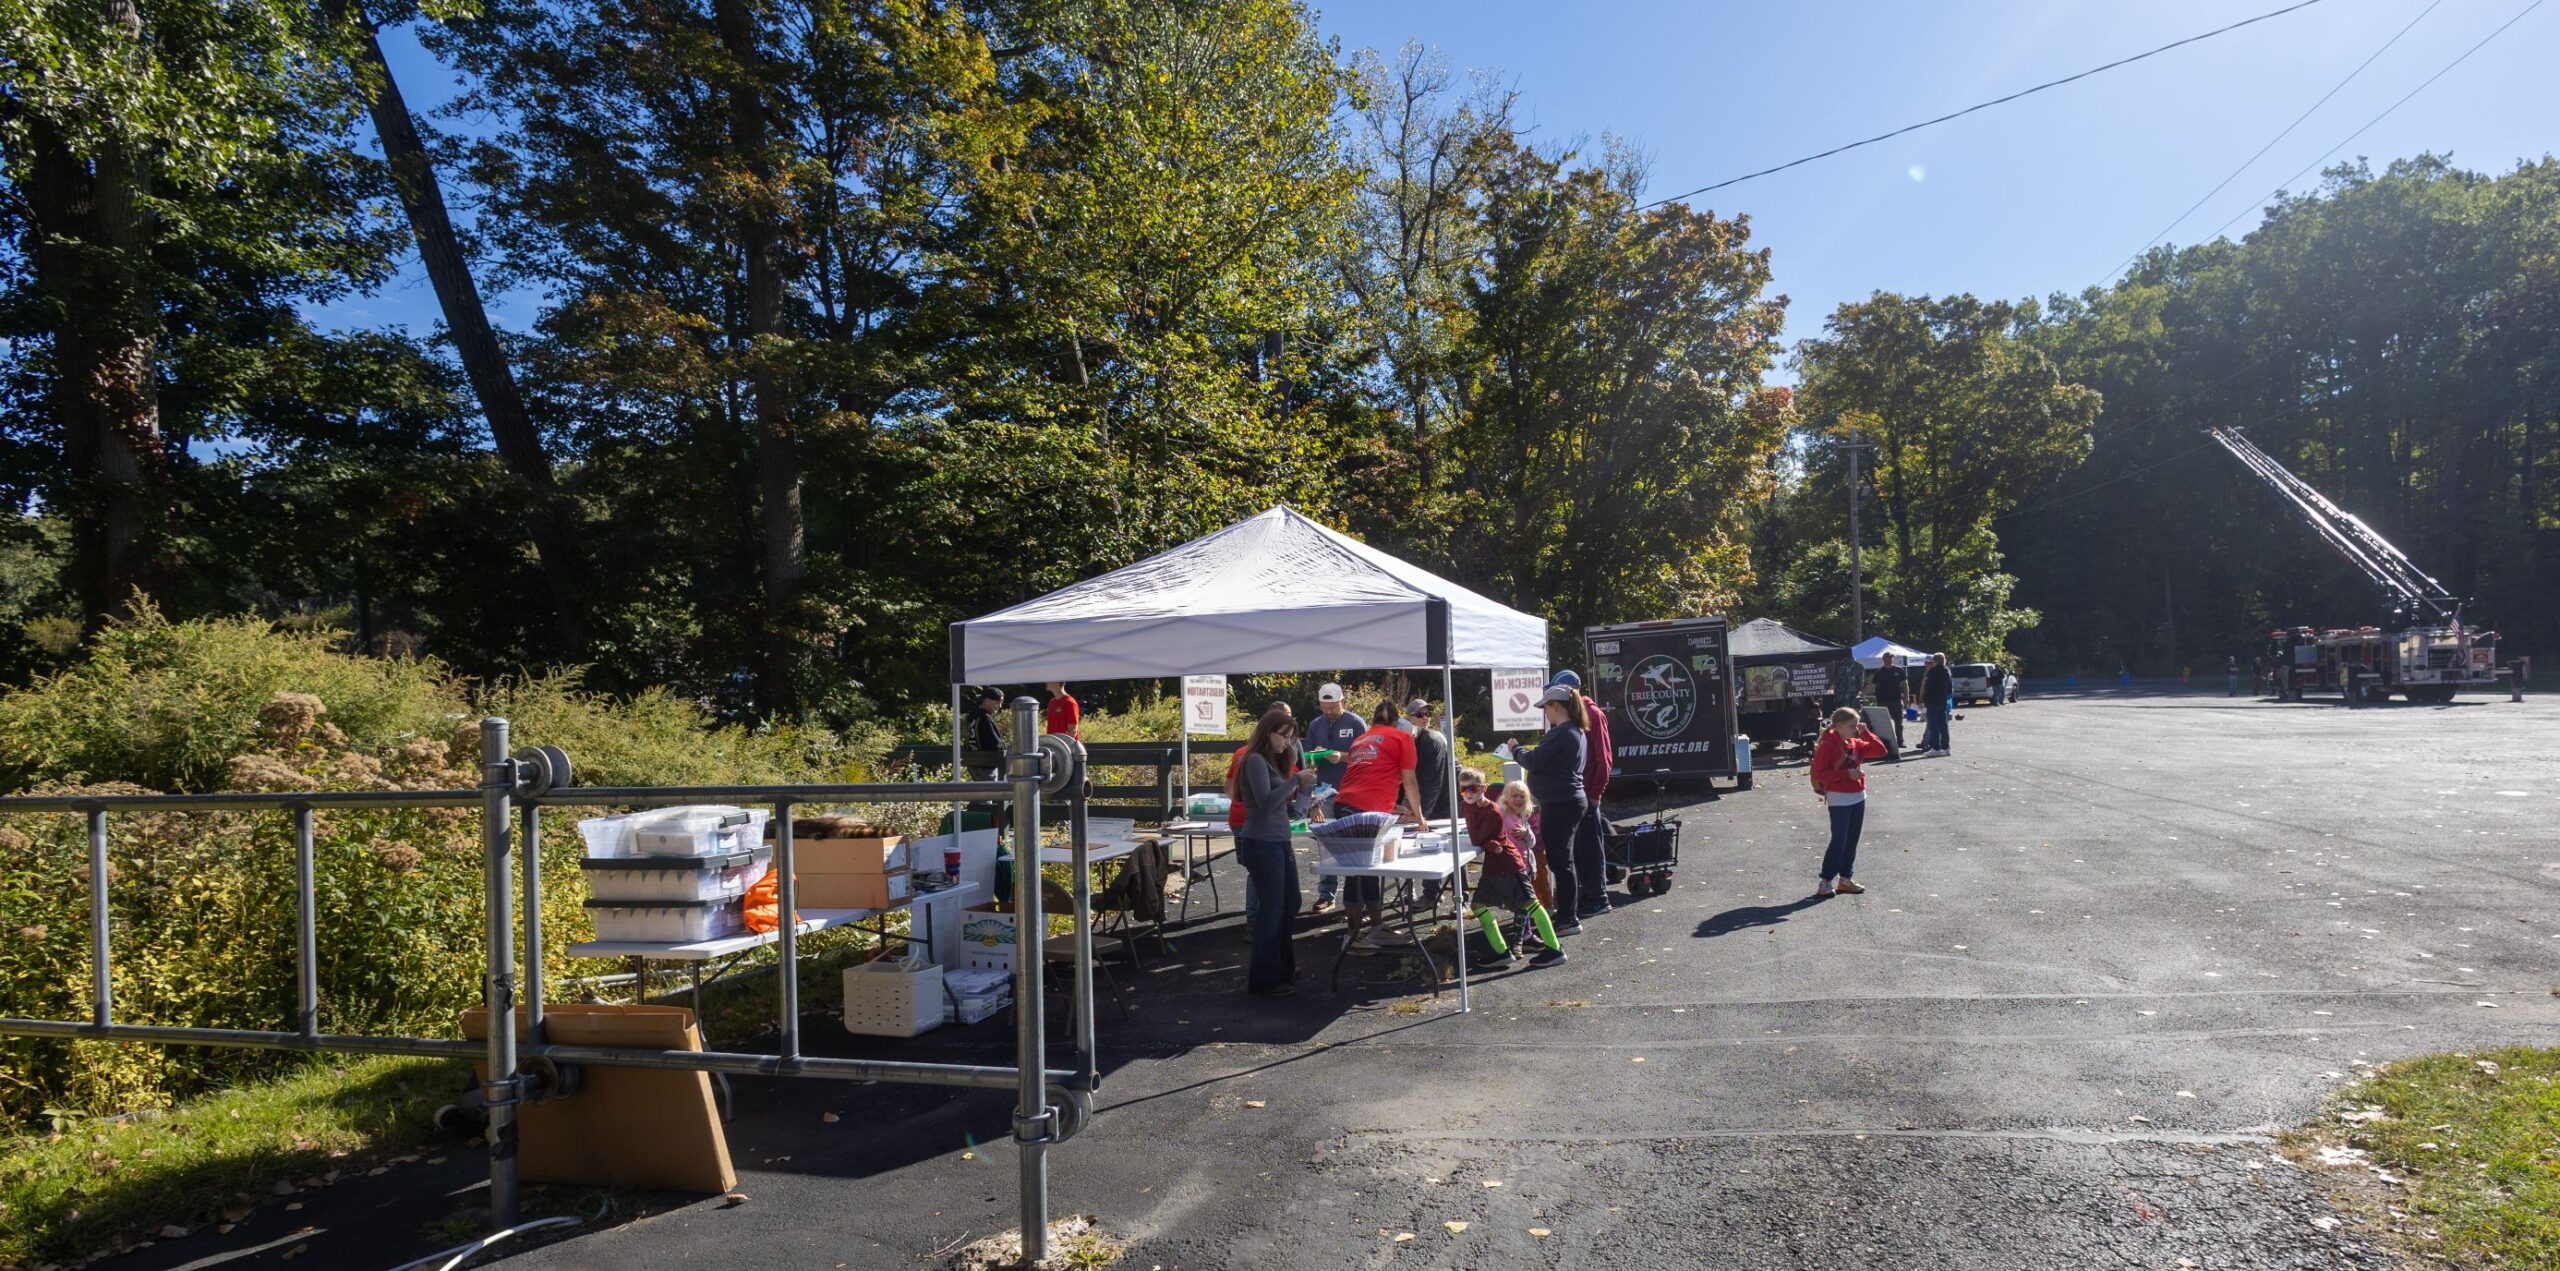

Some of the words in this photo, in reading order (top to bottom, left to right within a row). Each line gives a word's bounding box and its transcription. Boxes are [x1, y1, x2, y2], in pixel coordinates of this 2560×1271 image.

[1631, 691, 1651, 702] ERIE
[1652, 688, 1691, 701] COUNTY
[1617, 741, 1710, 758] WWW.ECFSC.ORG
